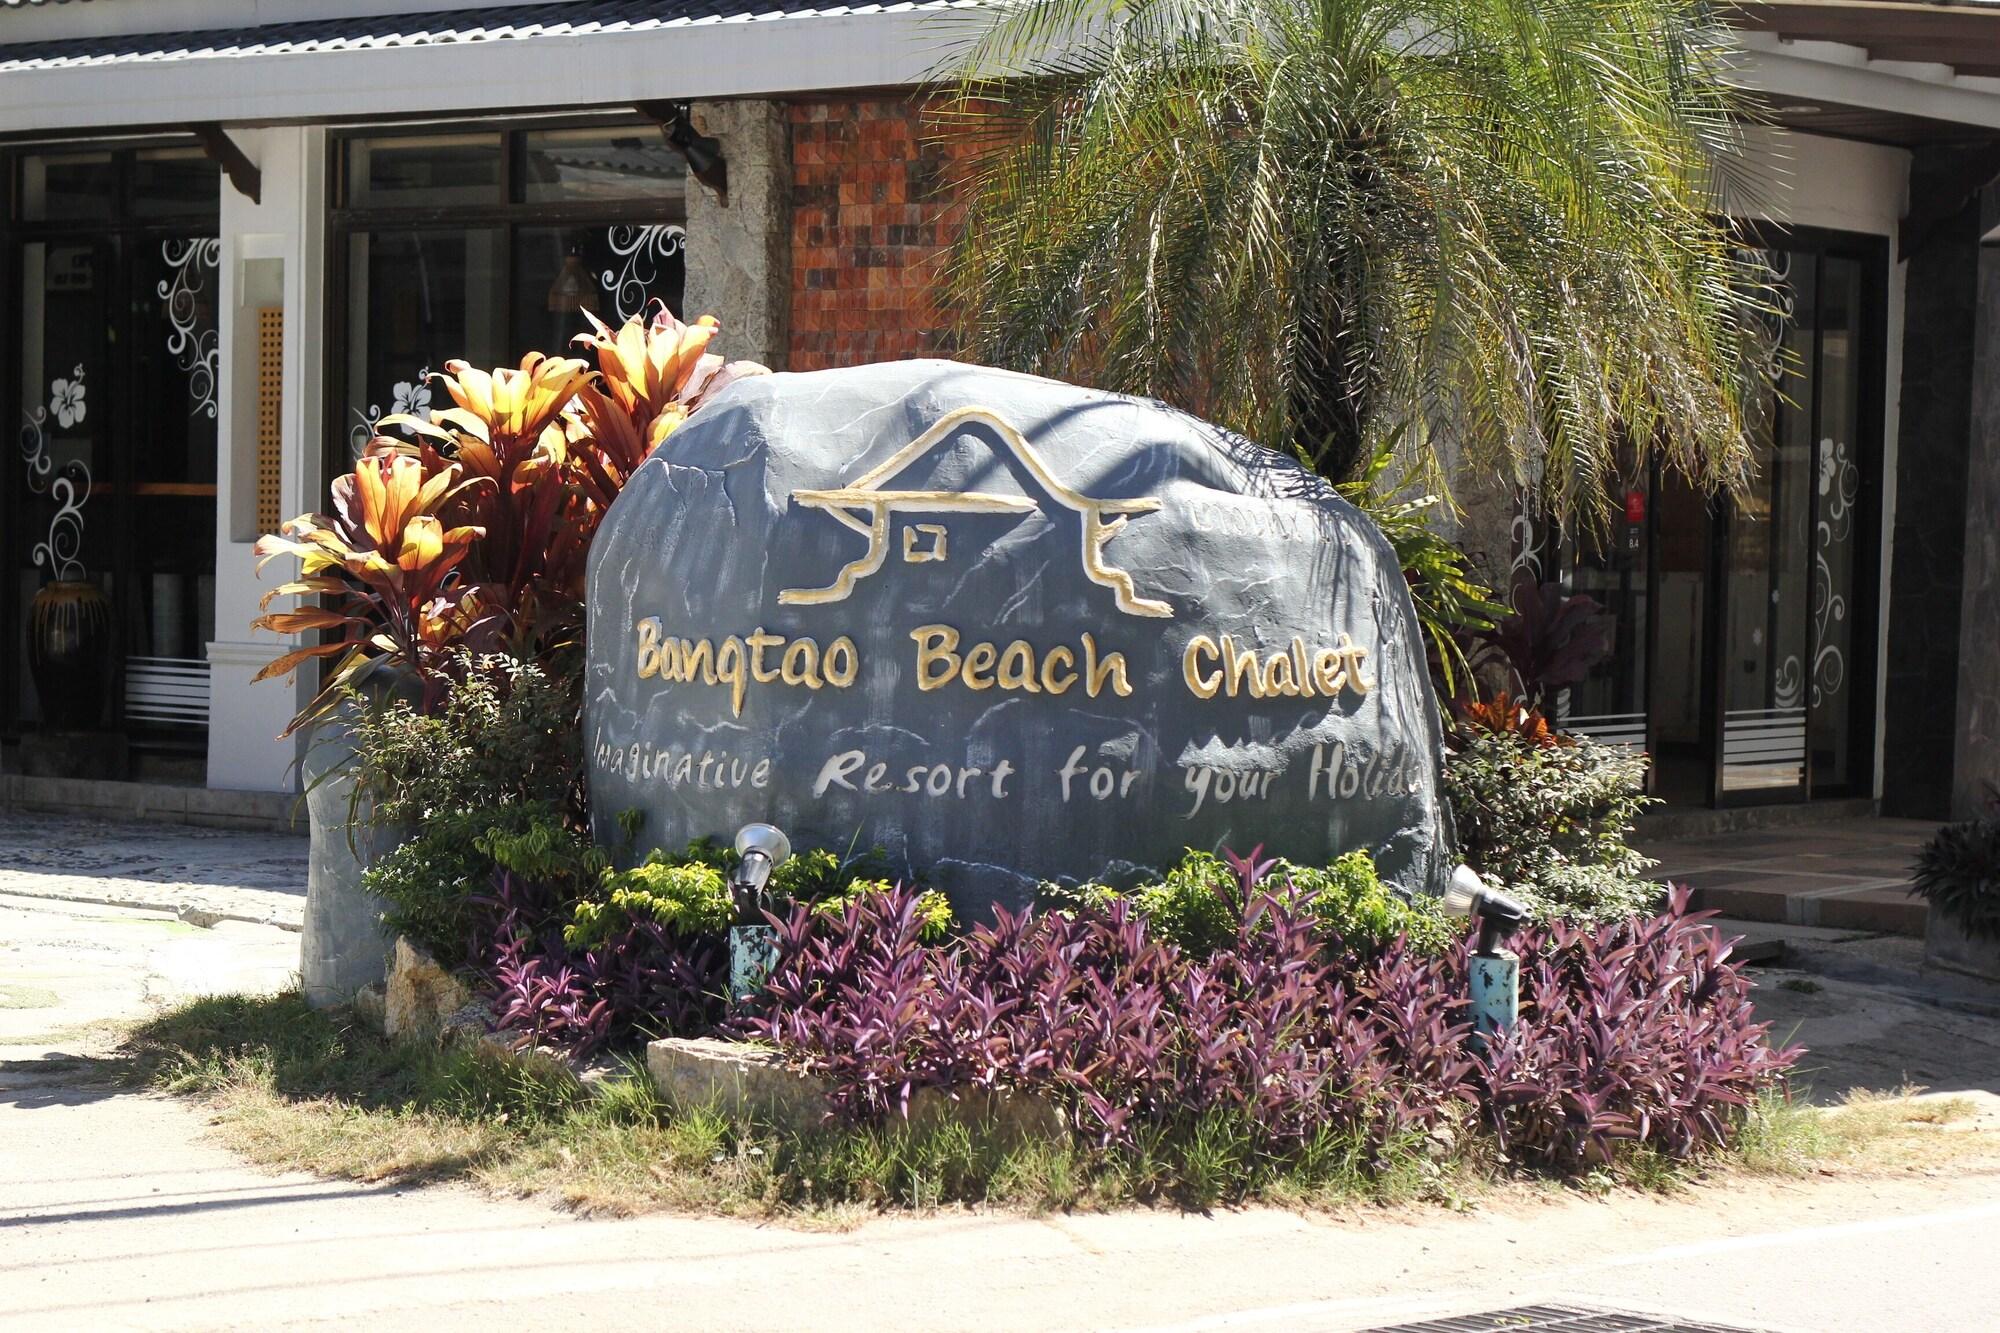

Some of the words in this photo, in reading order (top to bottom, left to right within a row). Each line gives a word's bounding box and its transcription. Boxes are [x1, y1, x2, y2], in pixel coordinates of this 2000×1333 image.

[909, 623, 1133, 698] Beach
[1183, 631, 1373, 699] Chalet
[593, 725, 771, 790] Imaginative
[812, 750, 1016, 799] Resort
[1055, 745, 1141, 802] for
[1179, 765, 1282, 820] your
